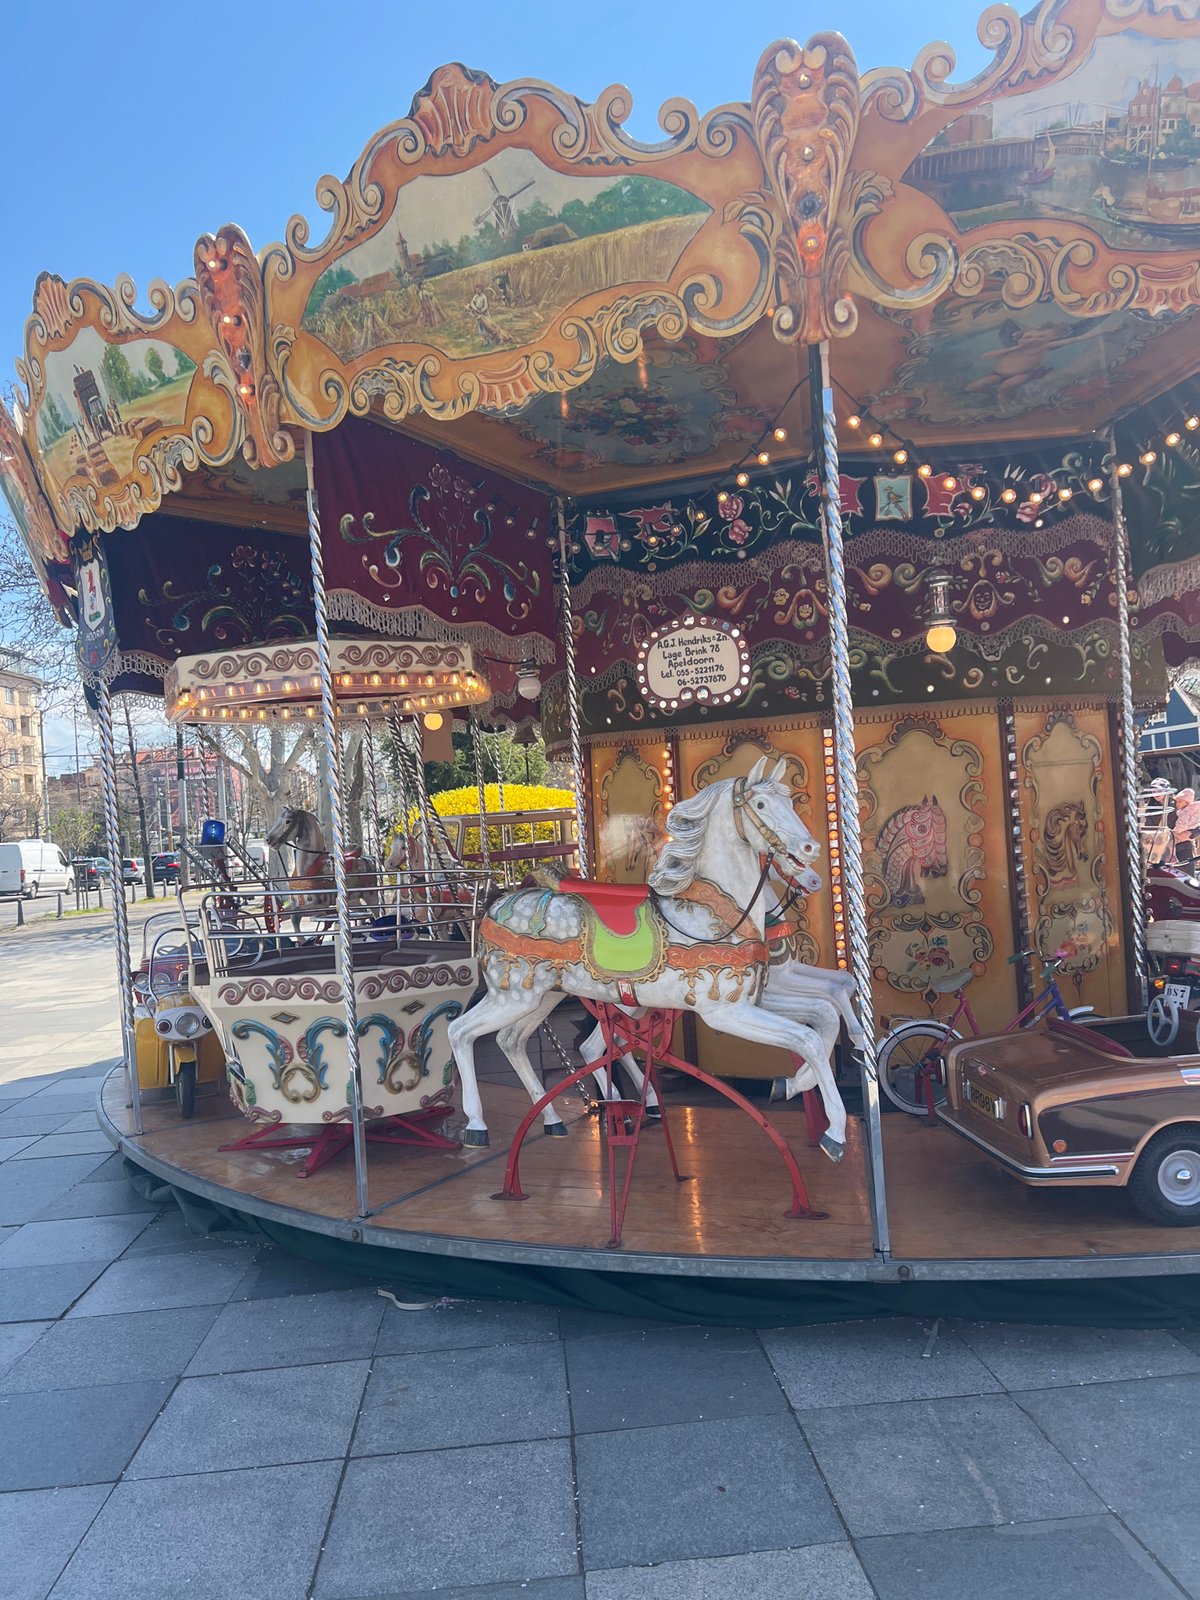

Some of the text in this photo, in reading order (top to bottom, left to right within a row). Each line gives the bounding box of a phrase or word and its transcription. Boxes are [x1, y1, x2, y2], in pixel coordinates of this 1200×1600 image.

[678, 634, 712, 647] Hendriks
[716, 633, 730, 642] Zn.
[662, 644, 720, 661] Lage Brink 78
[668, 657, 715, 670] Apeldoorn
[660, 669, 675, 679] tel.
